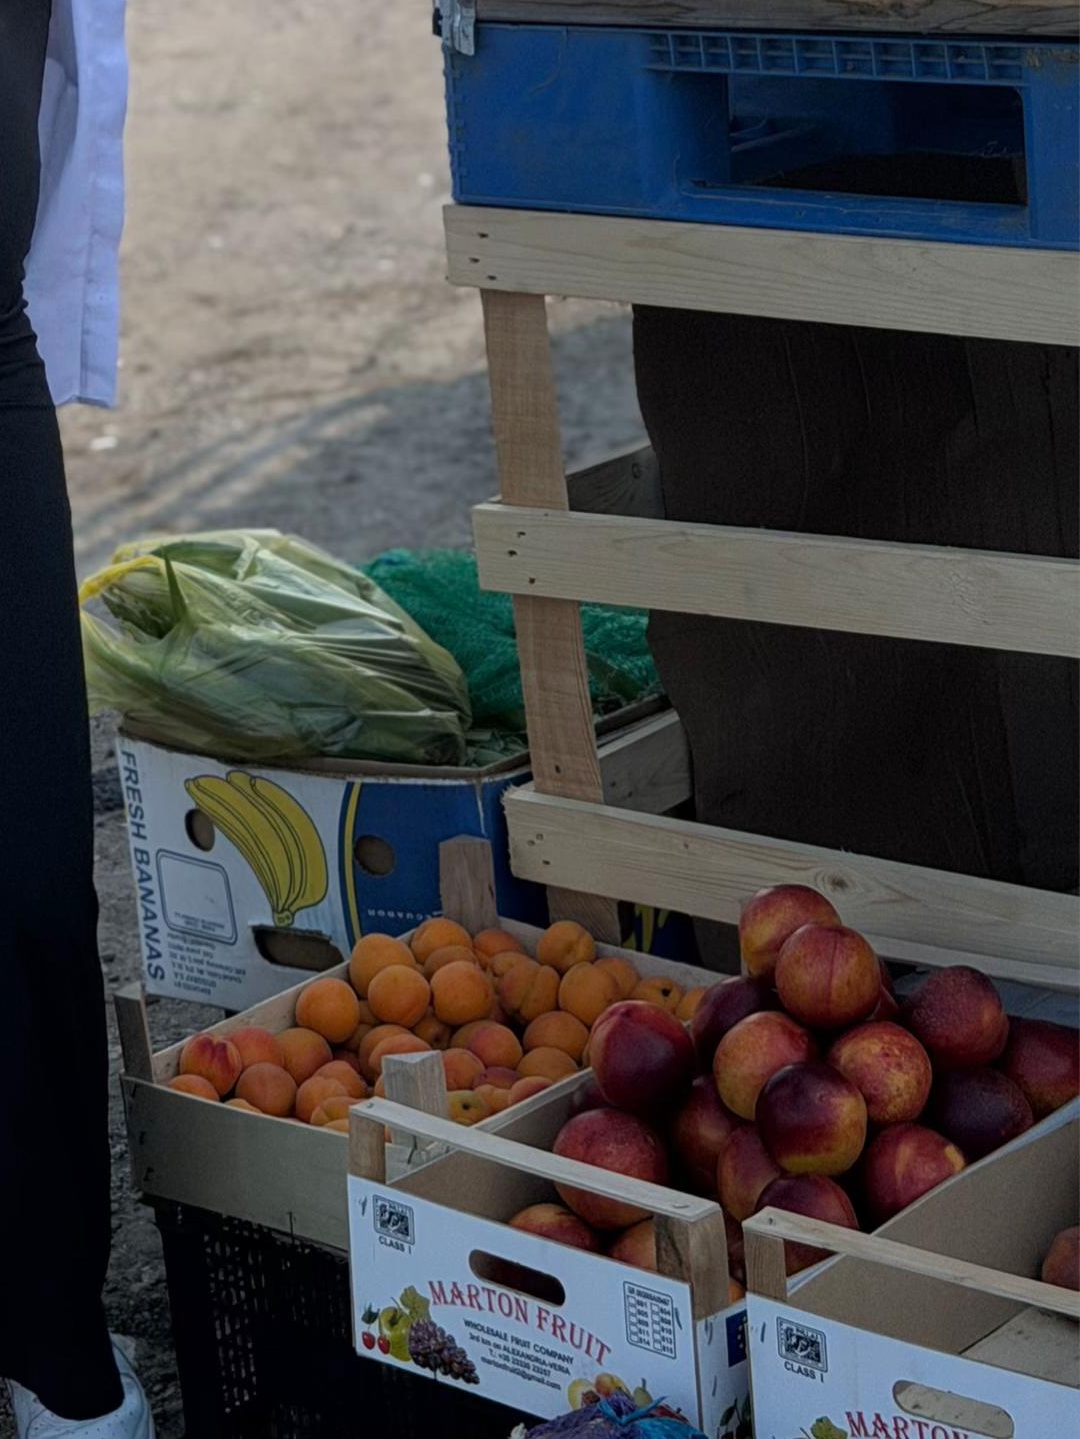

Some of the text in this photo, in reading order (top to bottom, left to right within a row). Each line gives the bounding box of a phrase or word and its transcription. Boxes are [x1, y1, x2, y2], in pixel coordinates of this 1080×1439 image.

[121, 749, 166, 981] FRESH BANANAS
[378, 1235, 406, 1252] CLASS
[428, 1280, 612, 1365] MARTON FRUIT
[463, 1318, 574, 1365] WHOLESALE FRUIT COMPANY
[784, 1360, 816, 1380] CLASS
